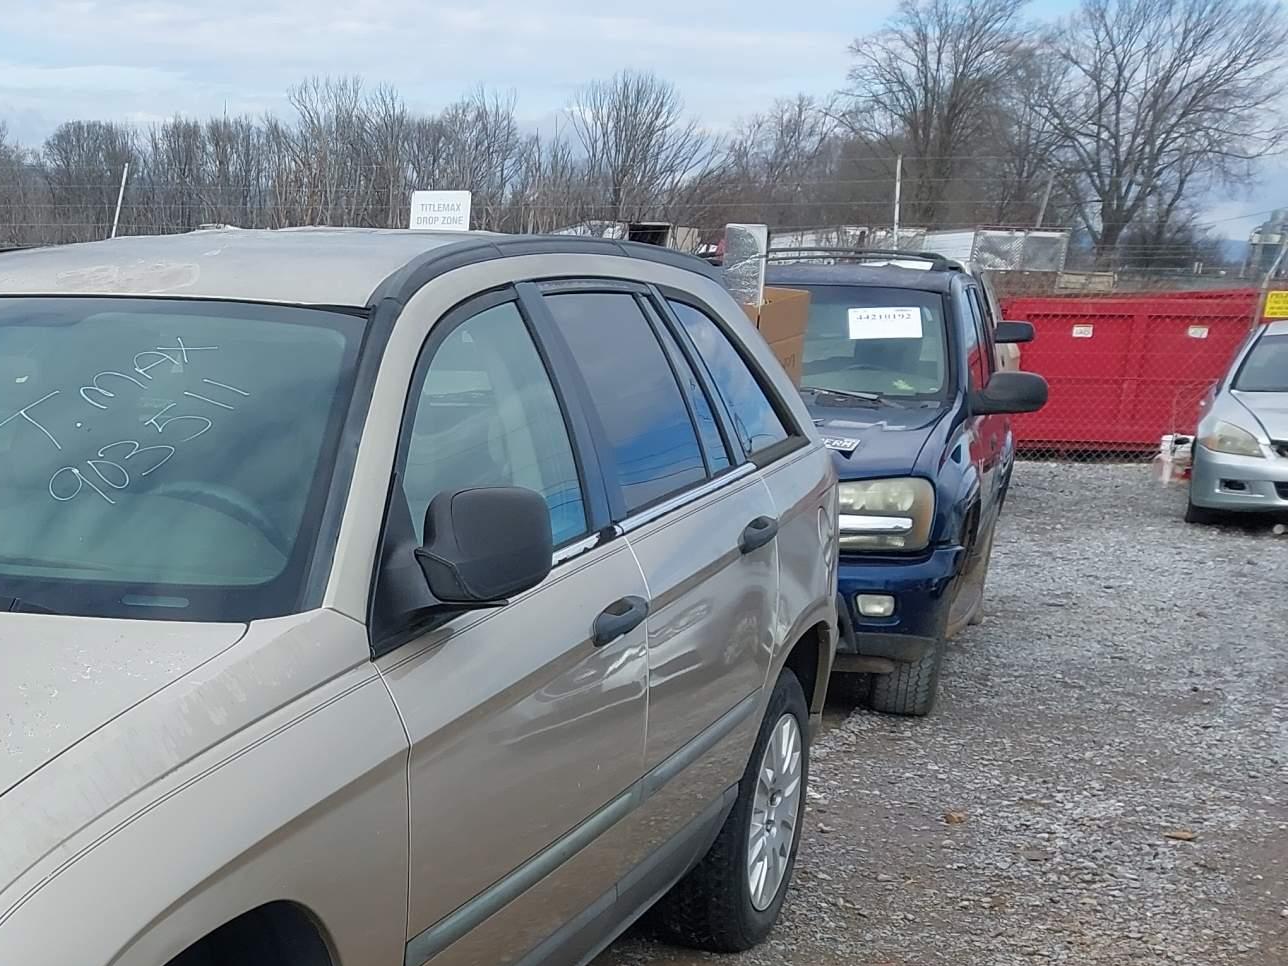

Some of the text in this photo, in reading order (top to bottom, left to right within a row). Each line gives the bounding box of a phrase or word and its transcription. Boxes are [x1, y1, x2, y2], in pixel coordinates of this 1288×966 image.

[418, 203, 462, 212] TITLEMAX
[416, 215, 464, 225] DROP ZONE
[49, 377, 251, 505] 903511
